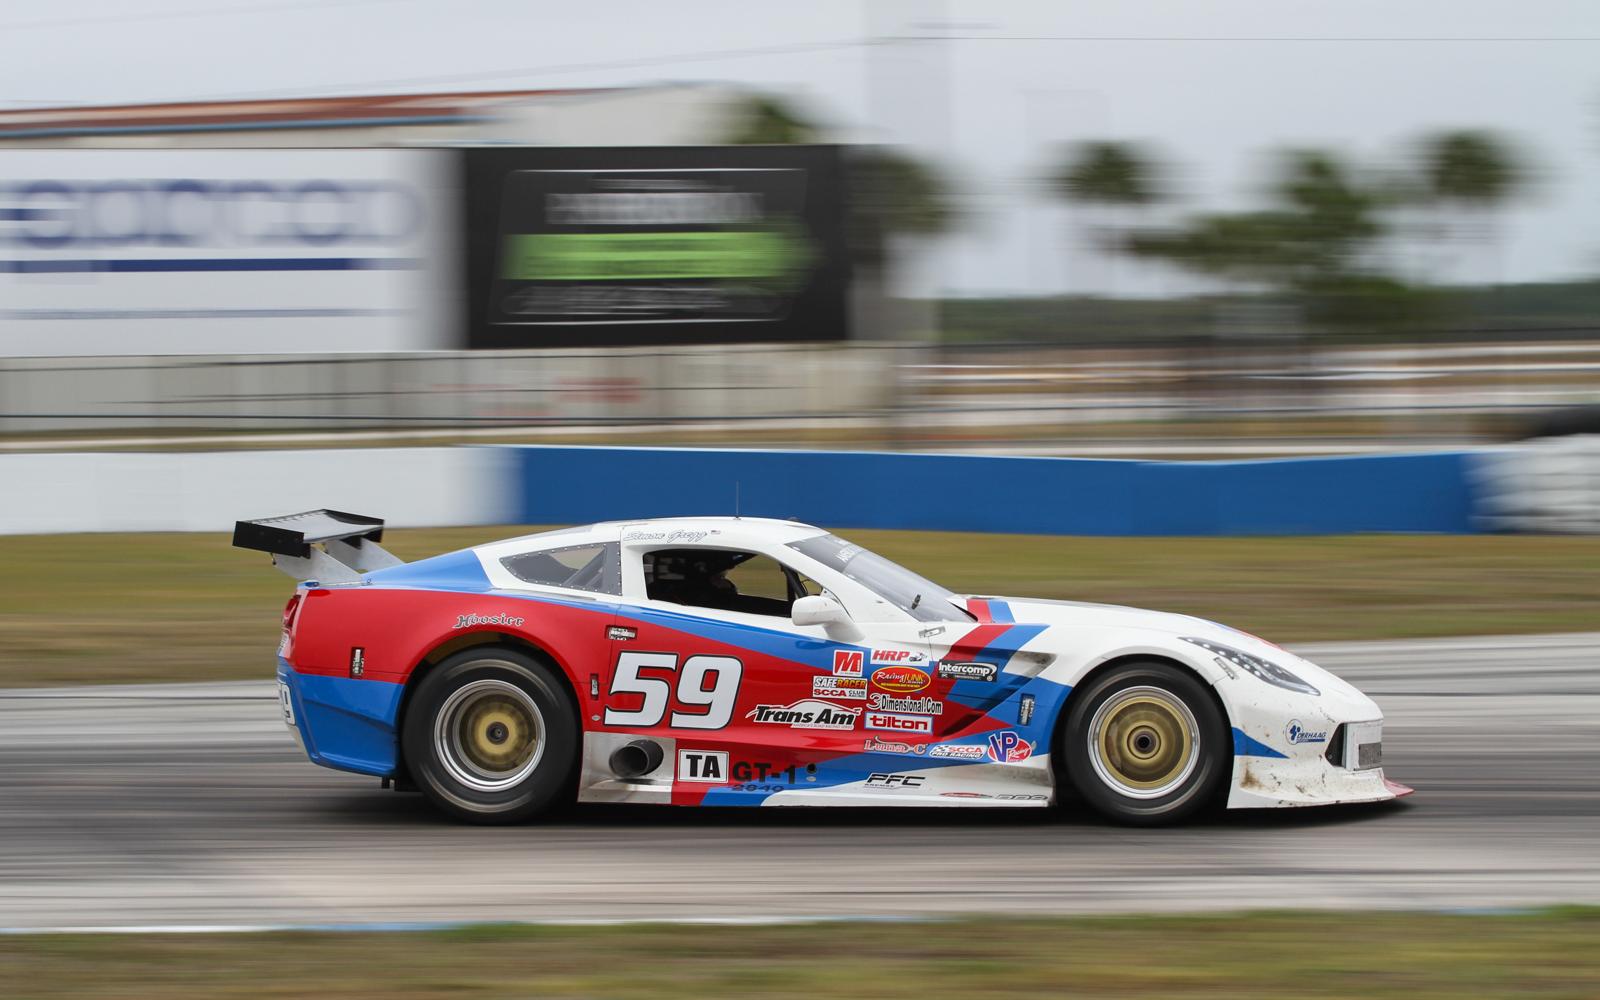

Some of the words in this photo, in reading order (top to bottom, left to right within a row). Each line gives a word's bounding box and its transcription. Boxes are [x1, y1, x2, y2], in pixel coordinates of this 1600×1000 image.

[453, 613, 525, 629] Hoosier
[872, 649, 910, 661] HRP
[938, 662, 991, 677] Intercomp
[604, 651, 743, 731] 59
[813, 689, 846, 697] SCCA
[754, 705, 814, 723] Trans
[814, 708, 856, 725] Am
[869, 714, 928, 730] tilton
[988, 731, 1019, 763] VP
[686, 755, 721, 778] TA
[733, 761, 796, 784] GT-1
[867, 773, 926, 787] PFC
